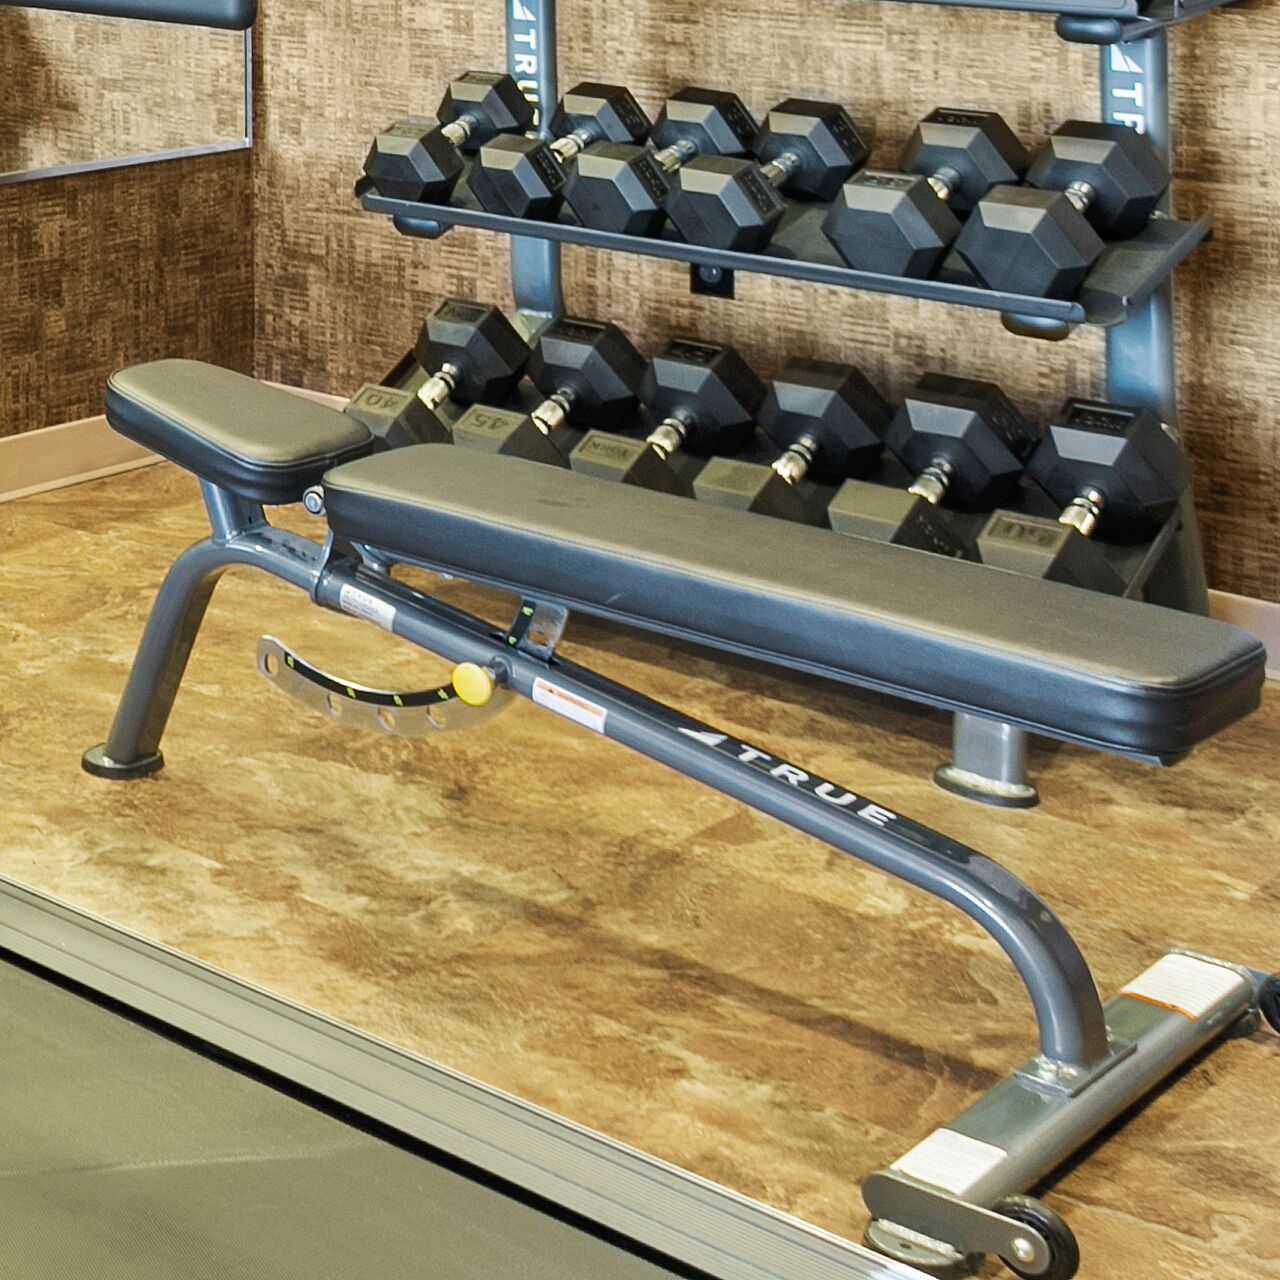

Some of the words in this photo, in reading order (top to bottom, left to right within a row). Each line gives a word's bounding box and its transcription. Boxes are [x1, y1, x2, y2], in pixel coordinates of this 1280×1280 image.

[514, 29, 539, 126] TRU
[365, 393, 399, 409] 40
[470, 412, 510, 430] 45
[738, 743, 897, 826] TRUE
